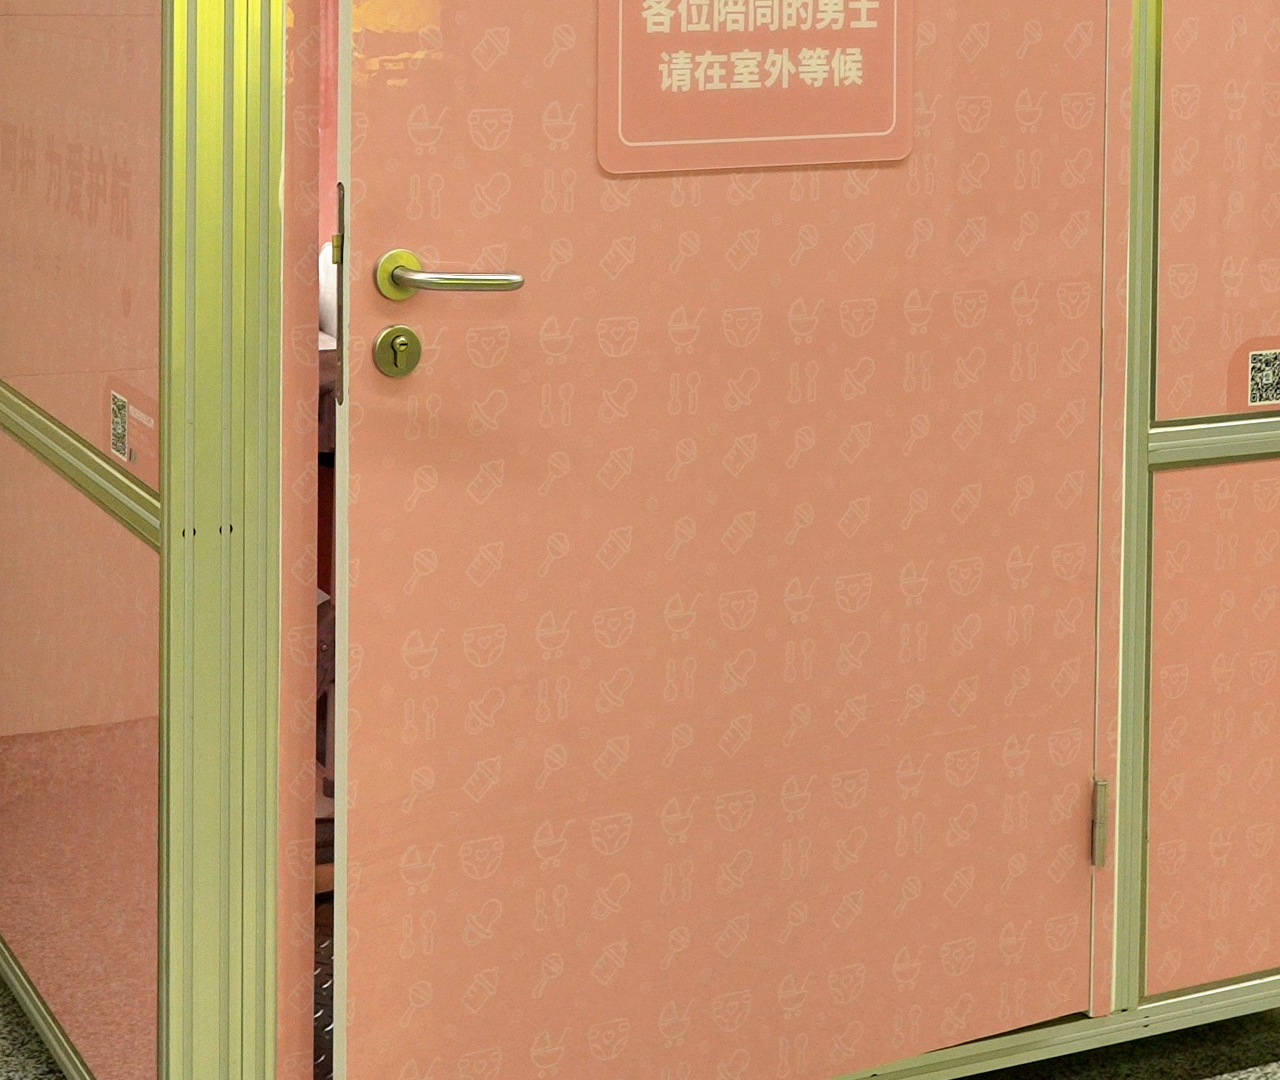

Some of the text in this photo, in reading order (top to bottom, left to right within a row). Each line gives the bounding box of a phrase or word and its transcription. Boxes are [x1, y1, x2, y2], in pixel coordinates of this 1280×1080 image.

[659, 48, 863, 92] 请在室外等候
